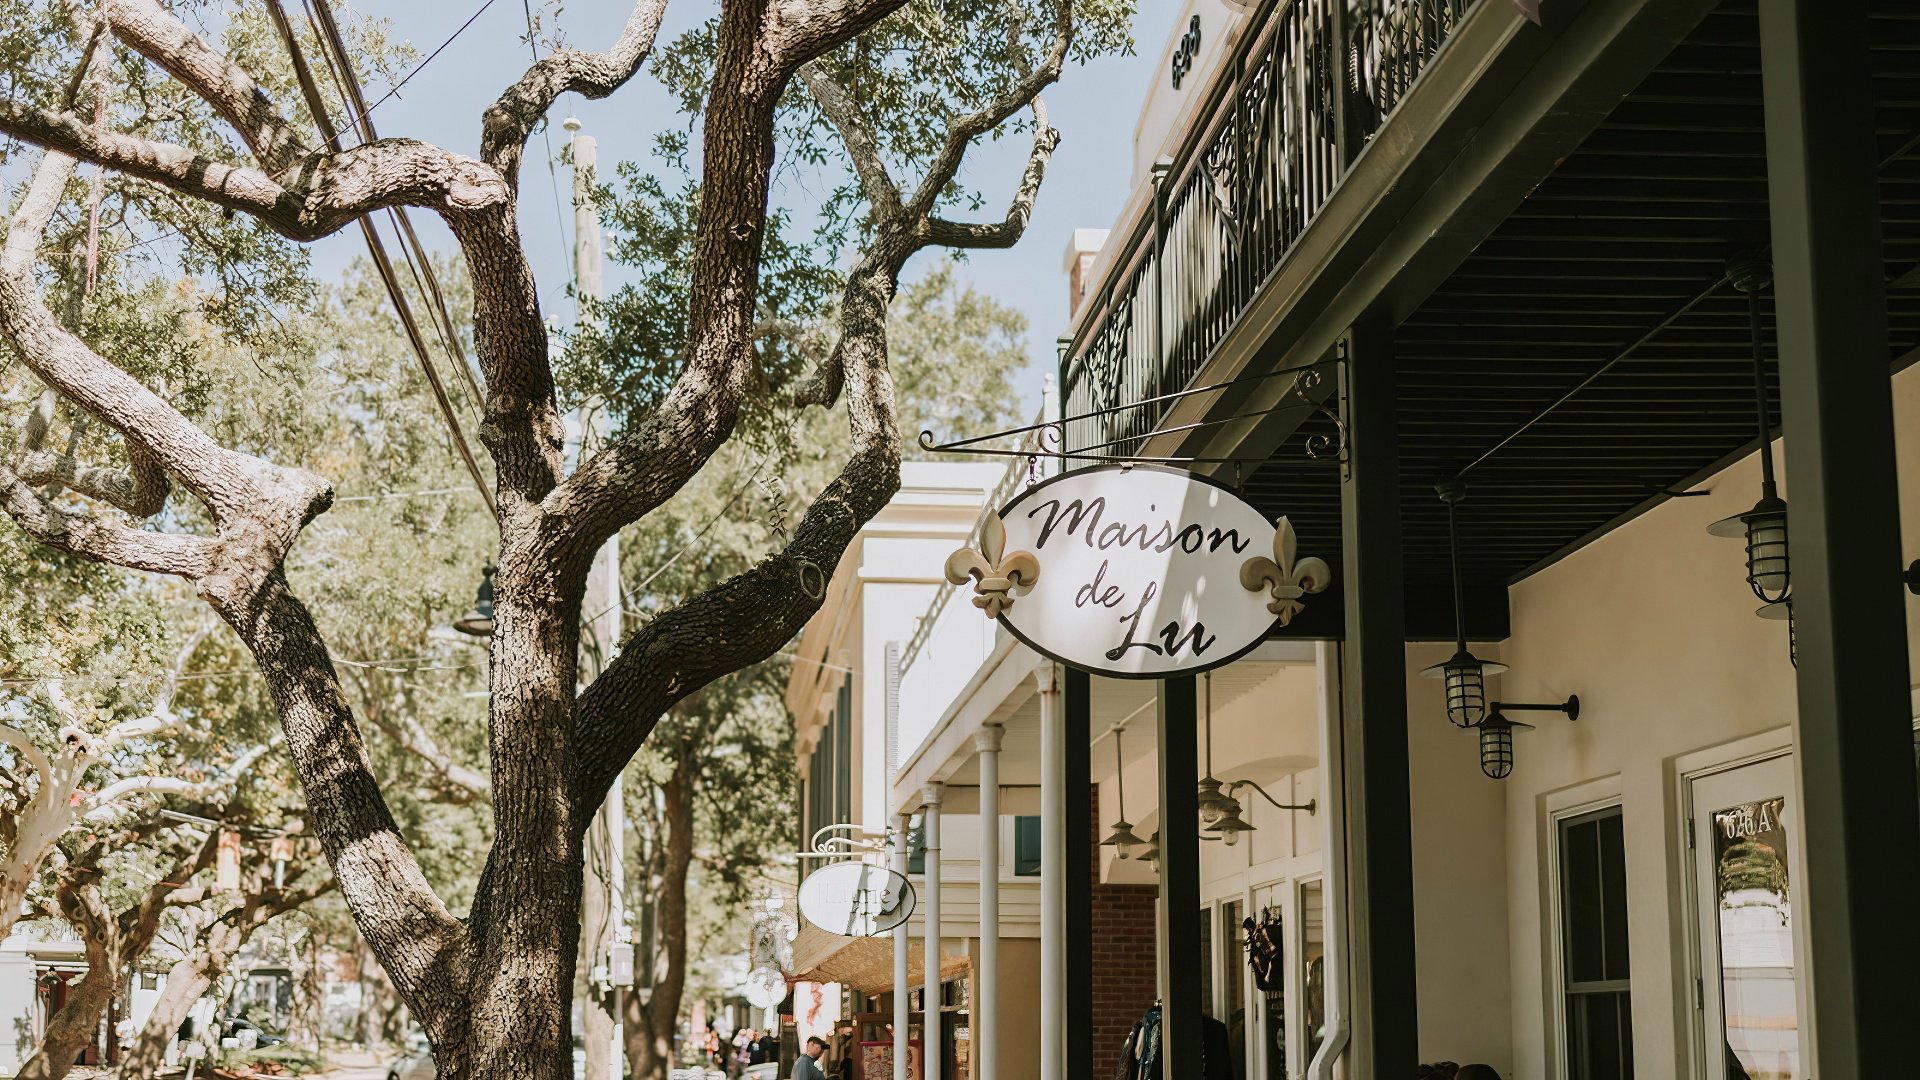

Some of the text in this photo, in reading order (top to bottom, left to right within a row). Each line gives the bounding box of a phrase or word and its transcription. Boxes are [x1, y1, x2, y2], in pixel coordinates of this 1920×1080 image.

[1028, 496, 1251, 555] Maison
[1075, 559, 1126, 609] de
[1105, 580, 1217, 662] Lu
